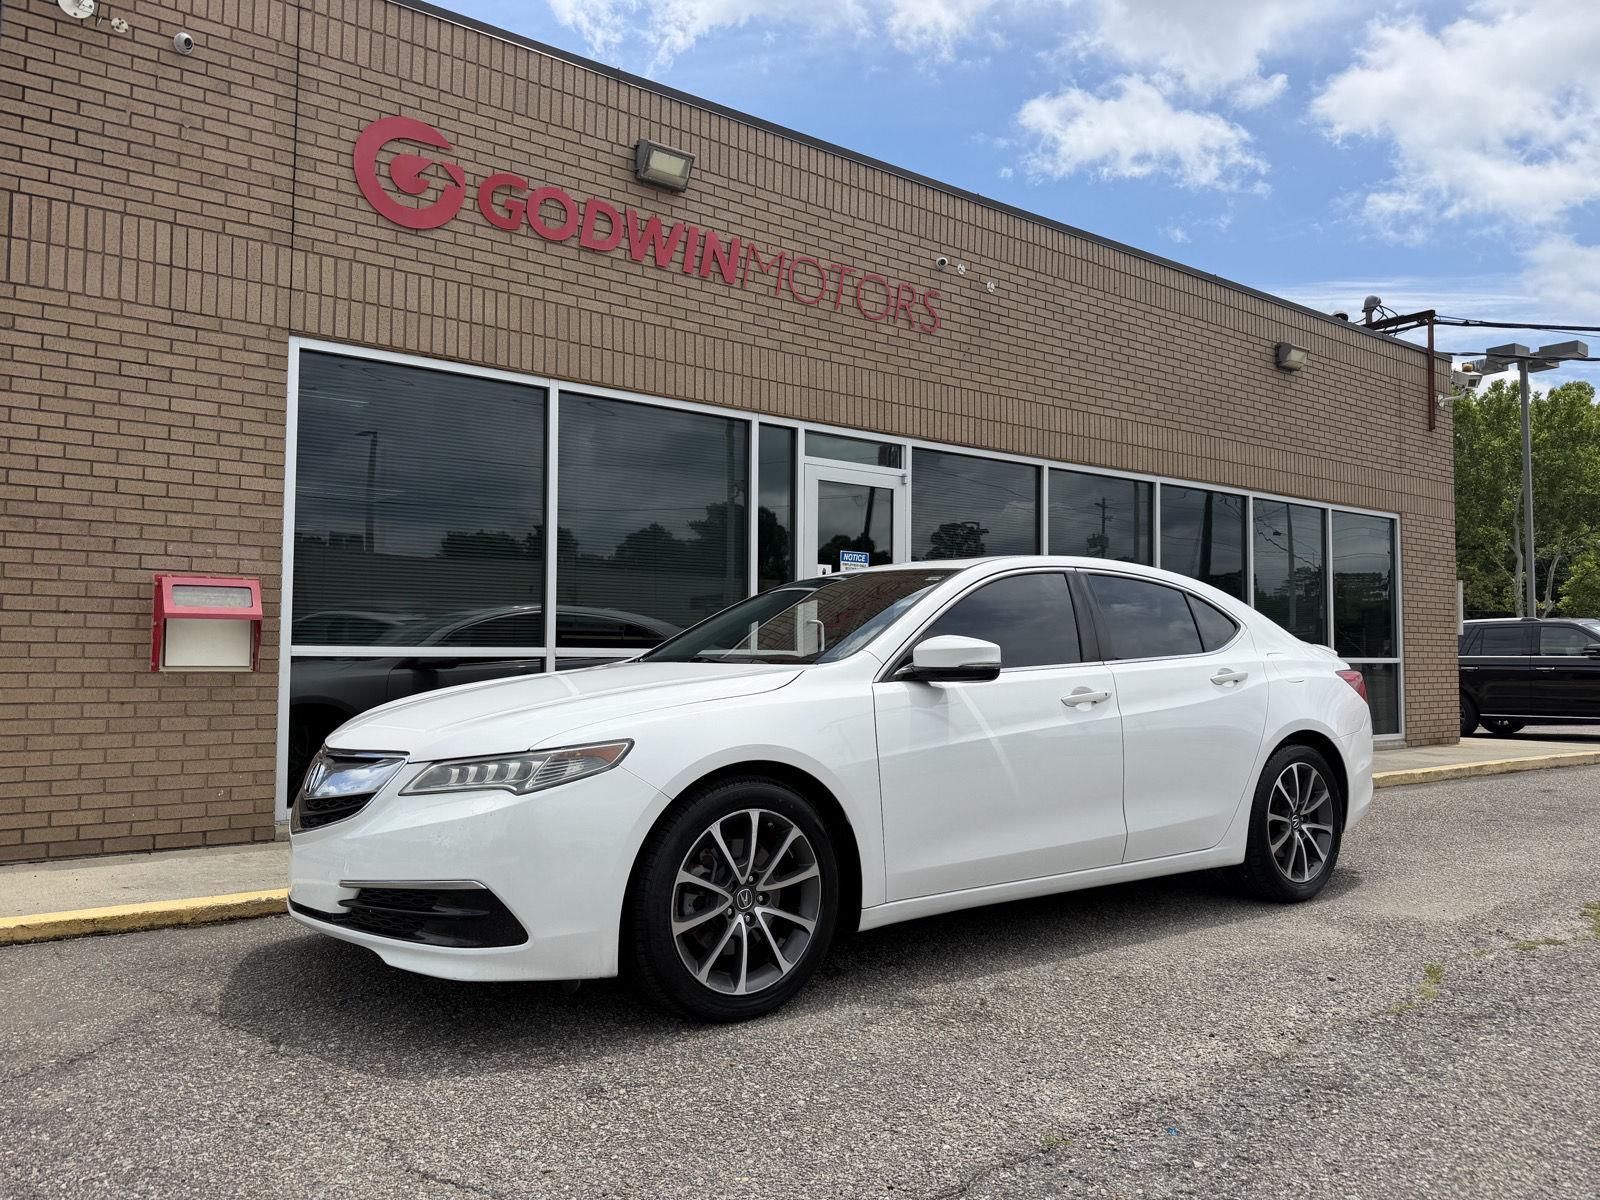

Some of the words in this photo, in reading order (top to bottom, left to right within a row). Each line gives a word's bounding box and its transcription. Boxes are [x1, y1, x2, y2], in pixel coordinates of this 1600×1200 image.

[477, 173, 742, 285] GODWIN
[743, 242, 942, 334] MOTORS
[843, 553, 866, 561] NOTICE
